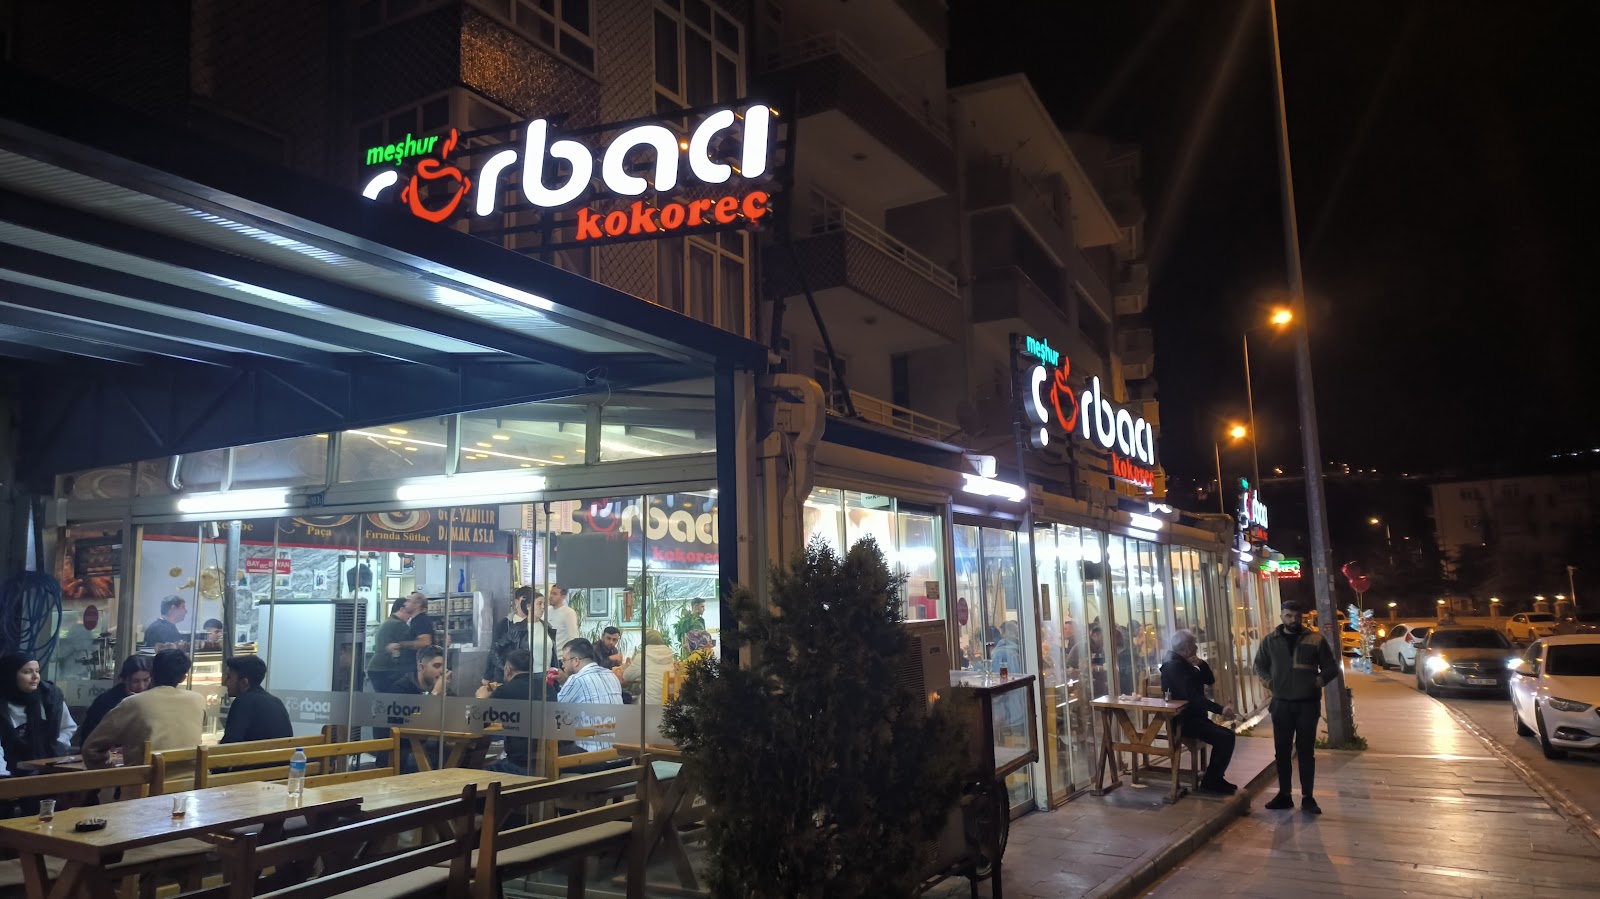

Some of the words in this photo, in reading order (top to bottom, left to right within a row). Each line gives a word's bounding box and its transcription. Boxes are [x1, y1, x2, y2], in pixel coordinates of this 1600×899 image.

[366, 132, 439, 166] meşhur
[575, 190, 770, 241] kokoreç
[1026, 335, 1060, 367] meşhur
[1111, 452, 1155, 489] kokoreç
[306, 526, 332, 537] Paça
[365, 529, 401, 541] Fırında
[402, 532, 431, 544] Sütlaç
[473, 528, 495, 544] ASLA
